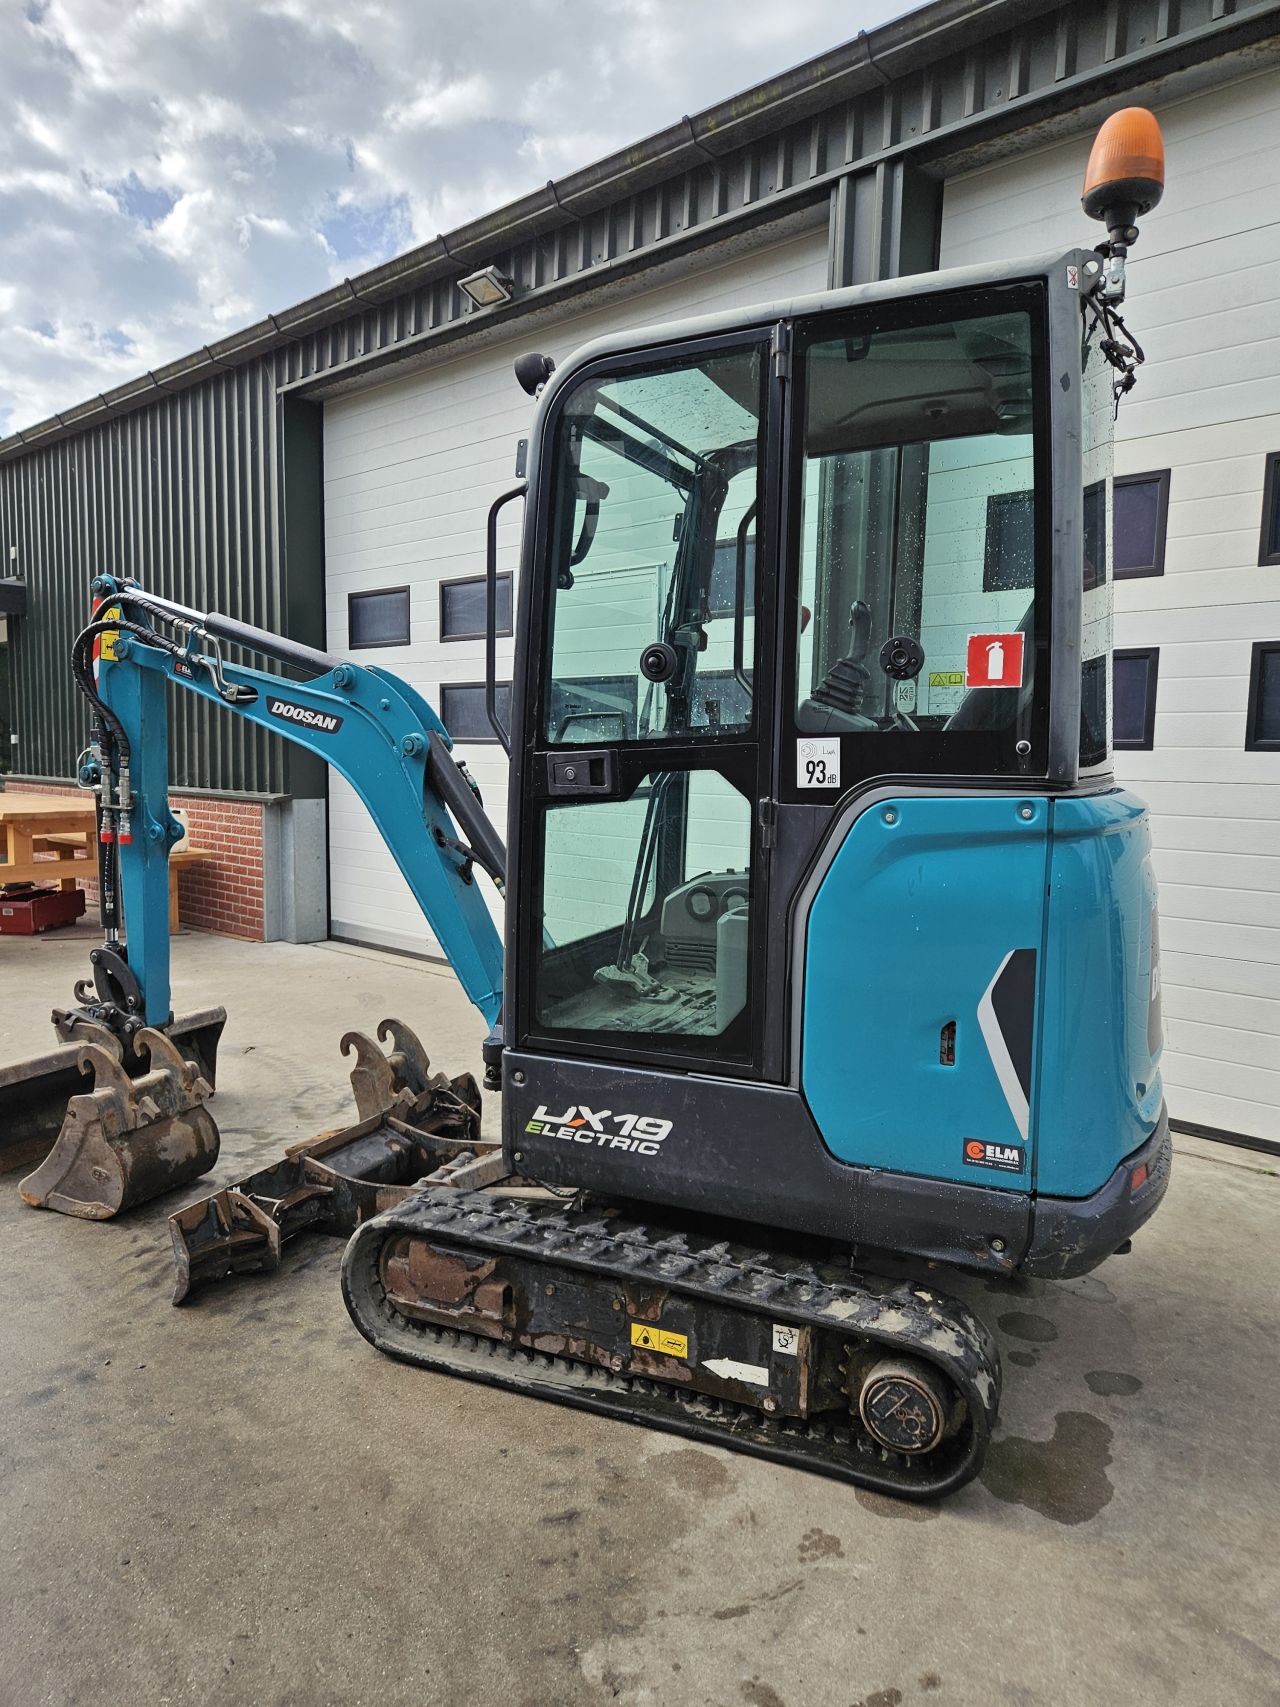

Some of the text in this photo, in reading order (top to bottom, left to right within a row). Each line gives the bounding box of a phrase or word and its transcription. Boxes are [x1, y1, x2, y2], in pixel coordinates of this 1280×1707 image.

[271, 701, 338, 730] DOOSAN
[806, 760, 837, 784] 93 dB
[525, 1120, 660, 1156] ELECTRIC
